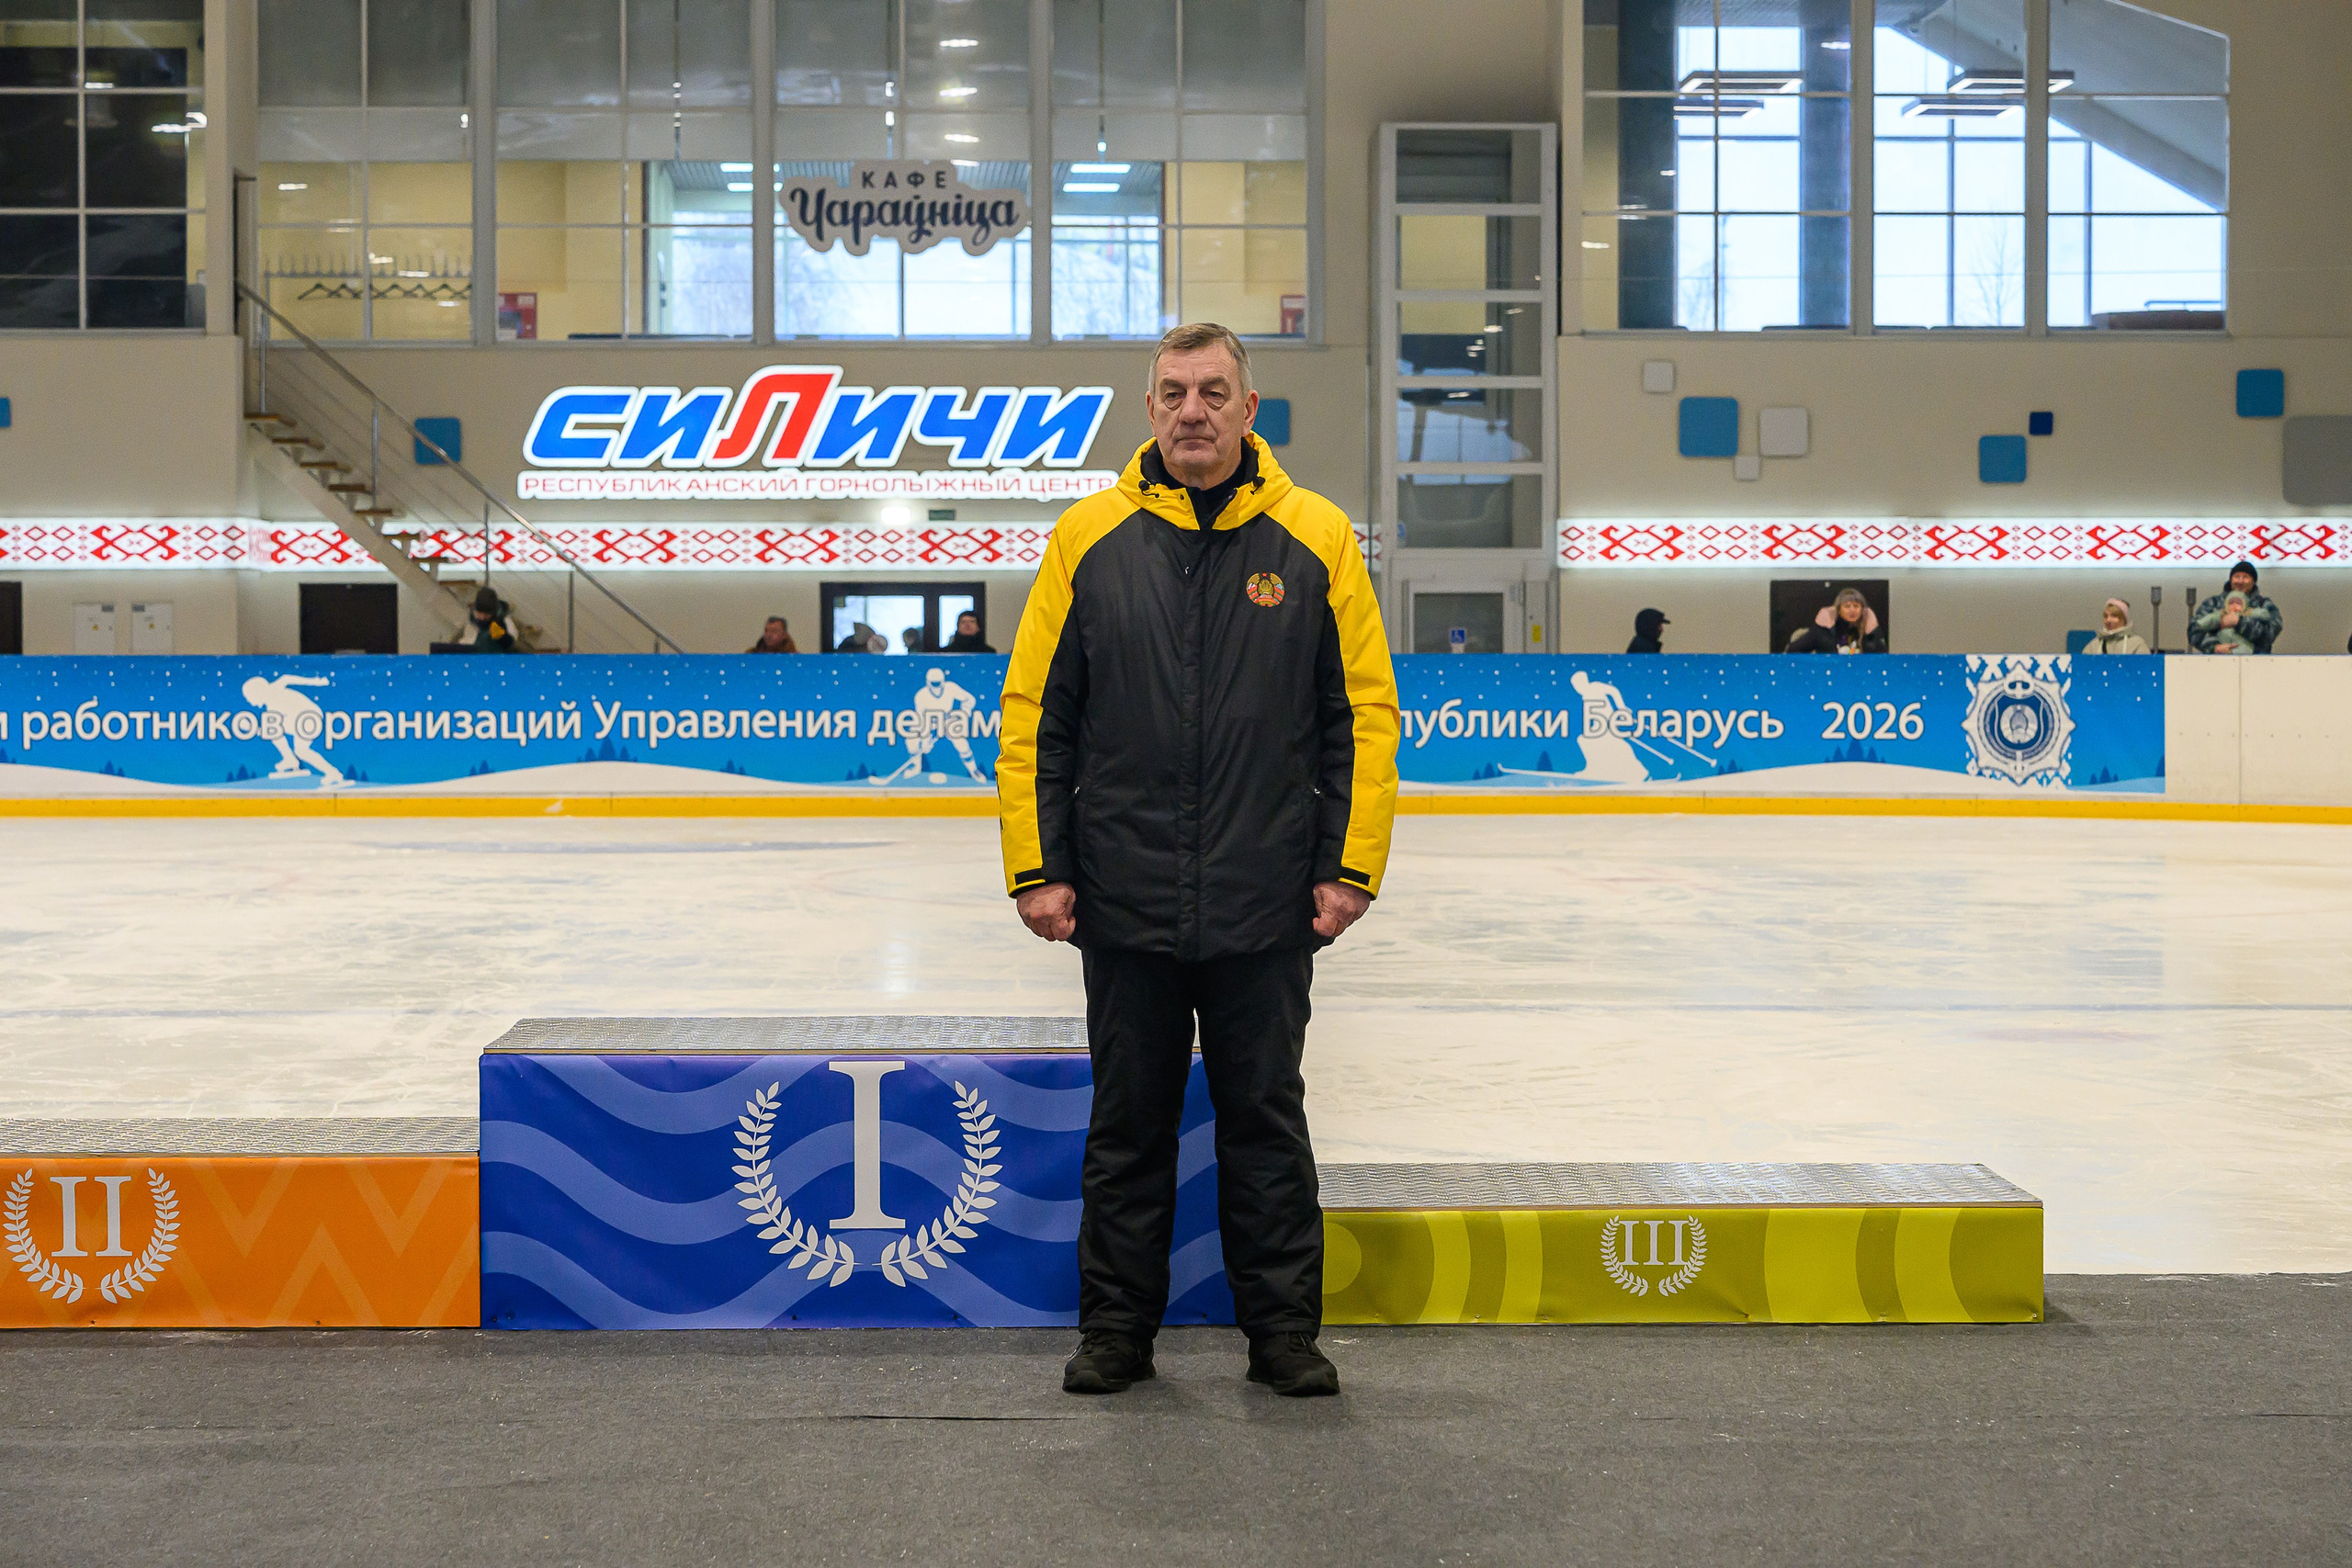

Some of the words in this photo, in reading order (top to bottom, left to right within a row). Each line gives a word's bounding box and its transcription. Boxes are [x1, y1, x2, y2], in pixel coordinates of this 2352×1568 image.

[862, 171, 946, 188] КАФЕ
[789, 187, 1020, 246] Чараўніца
[525, 471, 797, 492] РЕСПУБЛИКАНСКИЙ
[806, 473, 1021, 492] ГОРНОЛЫЖНЫЙ
[1030, 478, 1113, 496] ЦЕНТР
[22, 700, 285, 750] работников
[294, 700, 582, 750] организаций
[592, 700, 857, 750] Управления
[1582, 699, 1784, 749] Беларусь
[1821, 701, 1925, 740] 2026
[828, 1060, 906, 1229] I
[50, 1176, 133, 1257] II
[1618, 1220, 1689, 1265] III
